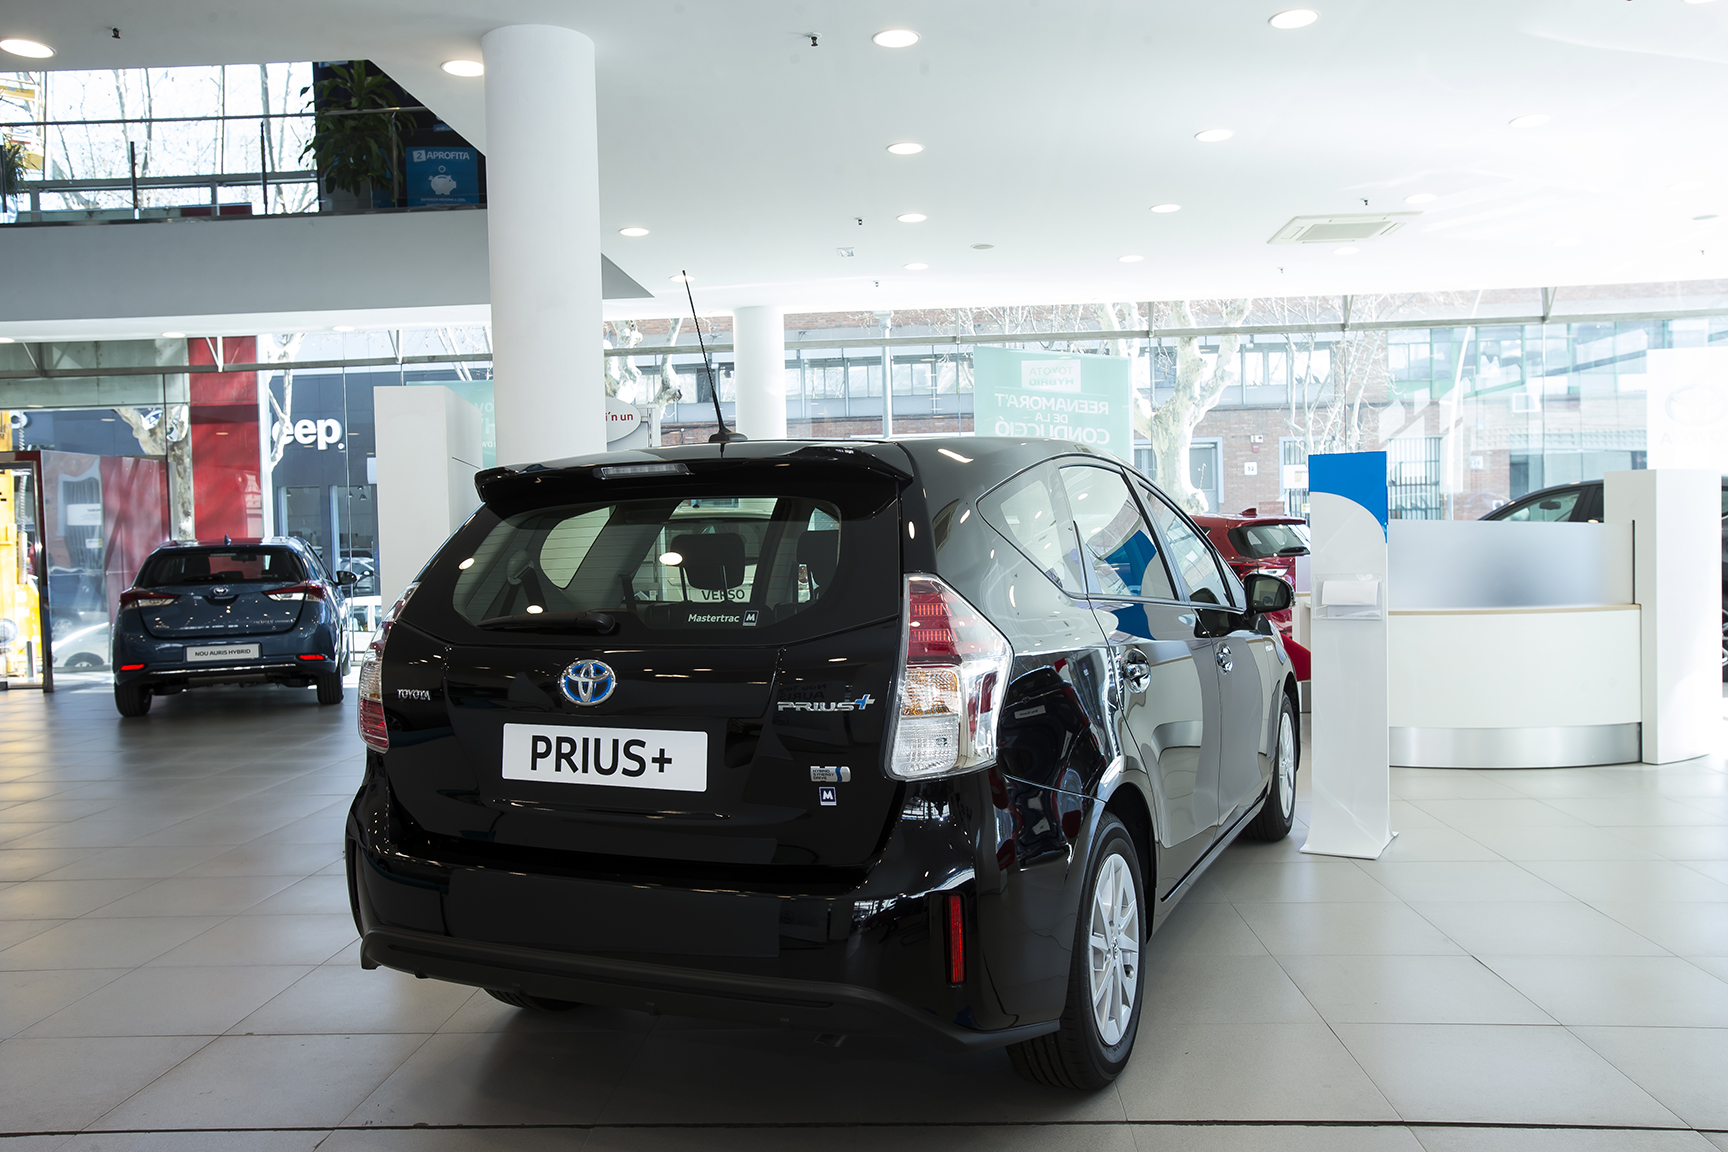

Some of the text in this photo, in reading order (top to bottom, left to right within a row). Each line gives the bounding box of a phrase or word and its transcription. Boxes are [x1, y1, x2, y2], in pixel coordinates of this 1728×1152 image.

[427, 151, 470, 160] APROFITA
[620, 413, 634, 421] un
[272, 418, 343, 450] eep
[688, 613, 740, 623] Mastertrac
[396, 688, 431, 701] TOYOTA
[530, 734, 673, 778] PRIUS+
